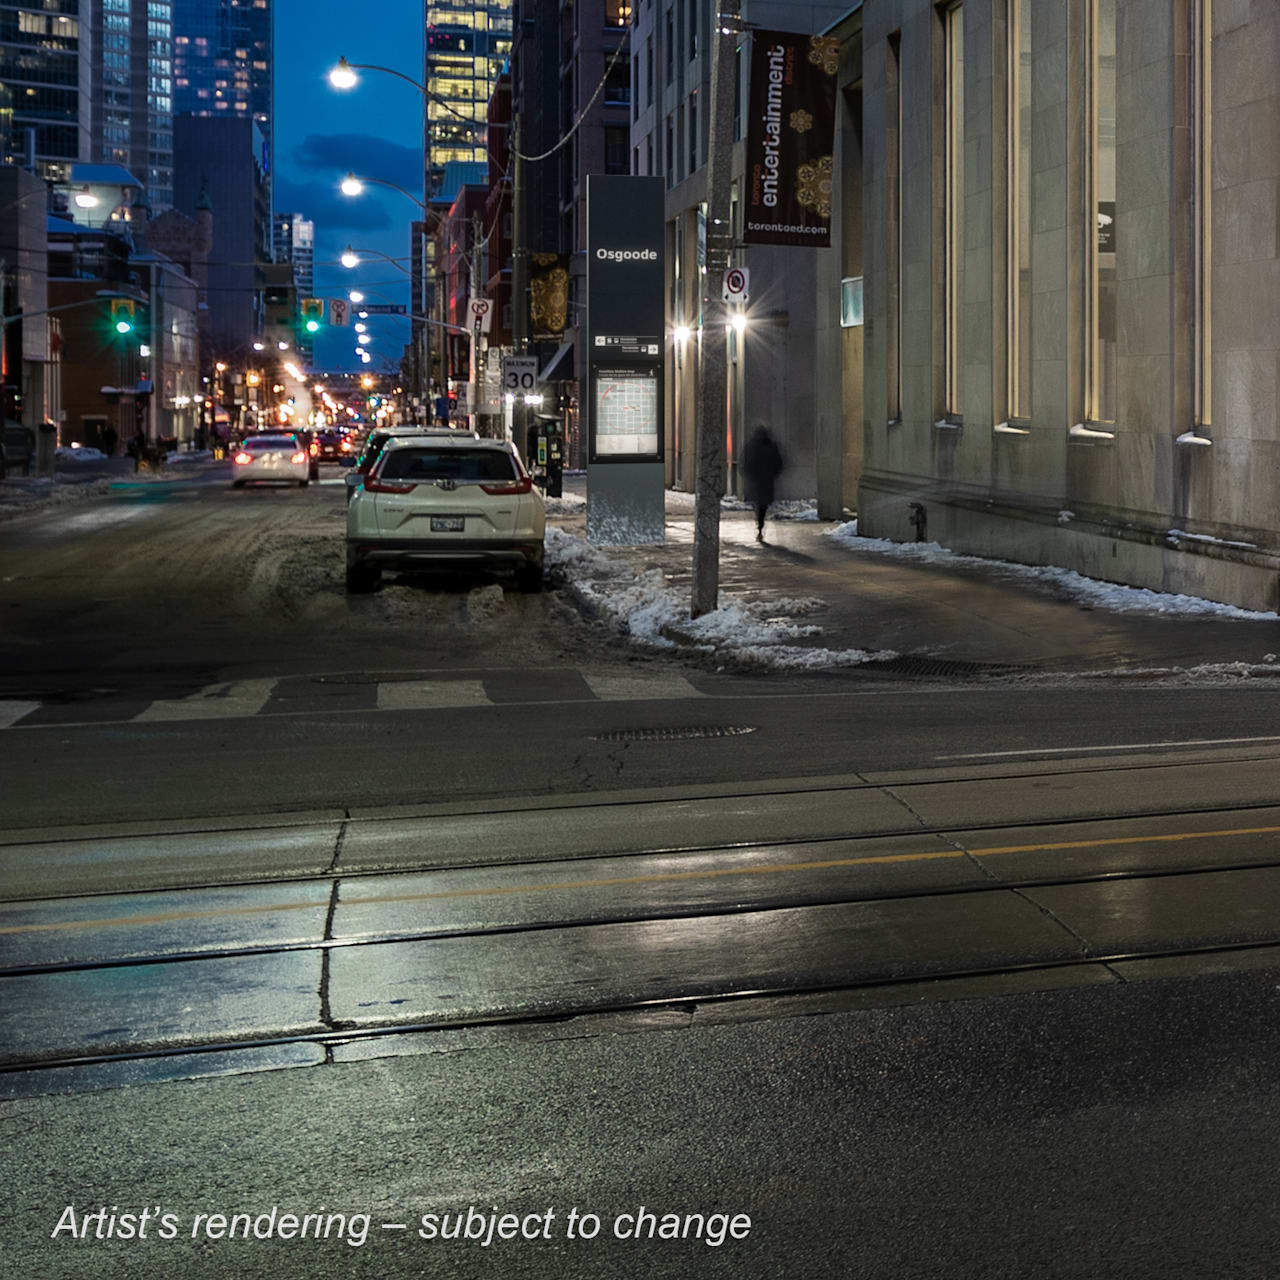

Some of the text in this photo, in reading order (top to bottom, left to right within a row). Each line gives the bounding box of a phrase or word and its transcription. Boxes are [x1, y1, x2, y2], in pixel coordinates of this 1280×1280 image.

[762, 44, 785, 207] entertainment
[747, 221, 828, 235] torontoed.com
[596, 248, 658, 263] Osgoode
[507, 372, 534, 389] 30
